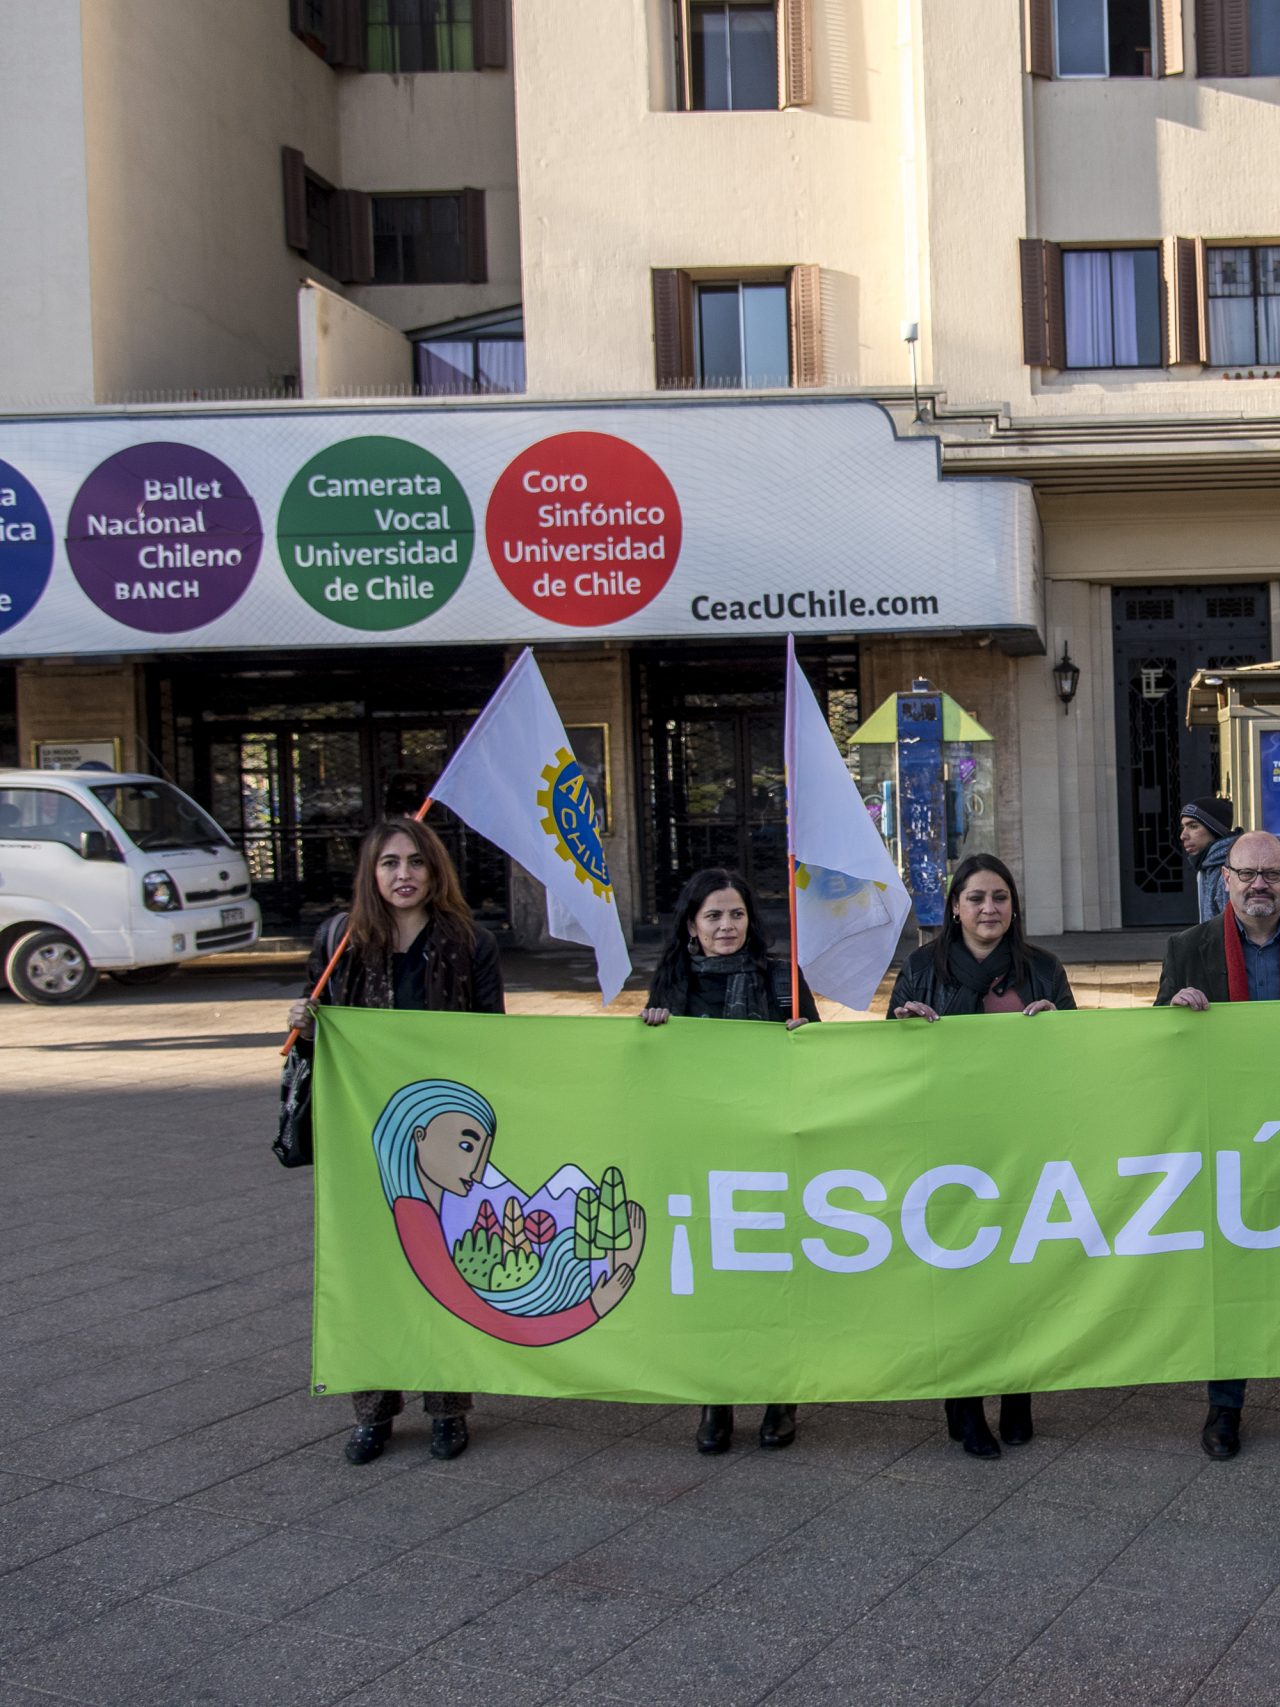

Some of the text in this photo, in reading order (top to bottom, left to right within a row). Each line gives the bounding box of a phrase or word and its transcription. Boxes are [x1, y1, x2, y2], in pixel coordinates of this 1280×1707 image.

[144, 476, 223, 501] Ballet
[308, 474, 442, 498] Camerata
[522, 470, 588, 493] Coro
[87, 511, 206, 536] Nacional
[374, 505, 450, 531] Vocal
[538, 501, 665, 528] Sinfónico
[138, 544, 242, 569] Chileno
[294, 539, 458, 568] Universidad
[503, 536, 666, 564] Universidad
[115, 580, 200, 600] BANCH
[324, 574, 434, 601] de Chile
[533, 571, 641, 598] de Chile
[691, 589, 939, 622] CeacUChile.com
